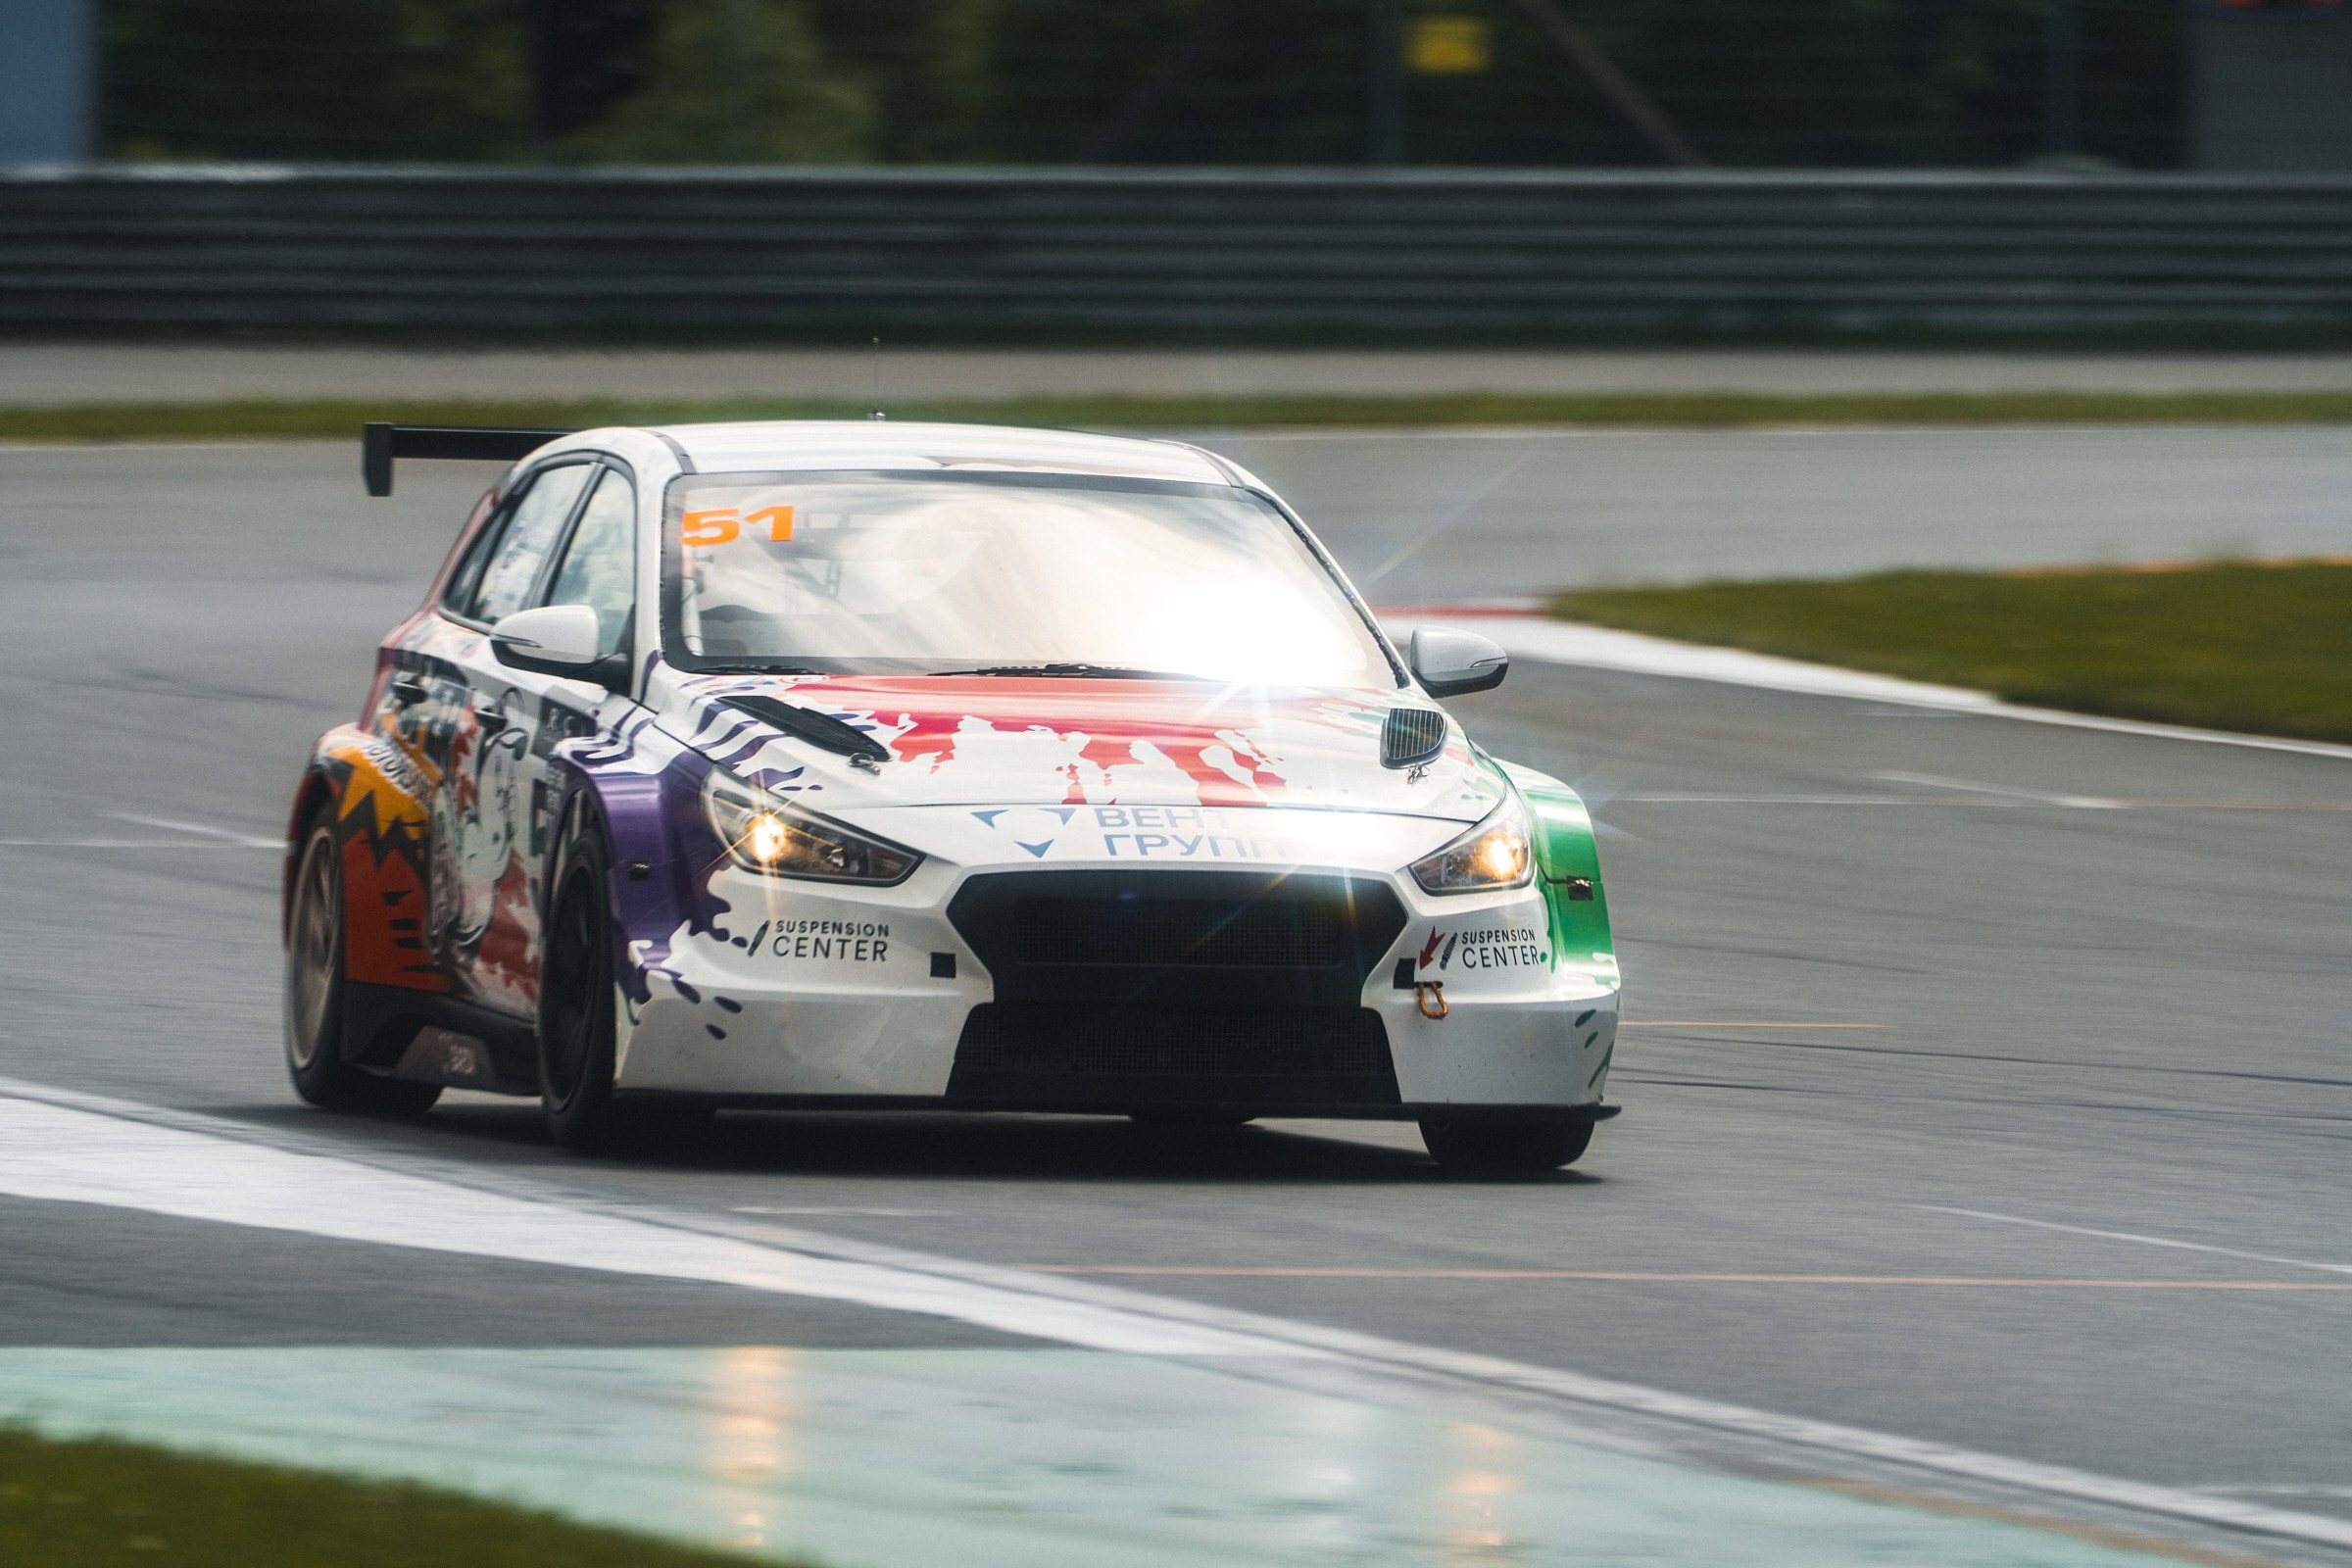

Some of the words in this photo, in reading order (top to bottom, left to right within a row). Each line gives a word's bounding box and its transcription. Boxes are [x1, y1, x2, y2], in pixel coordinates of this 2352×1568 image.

[679, 505, 794, 547] 51
[776, 920, 890, 938] SUSPENSION
[1461, 929, 1536, 945] SUSPENSION
[772, 936, 888, 962] CENTER
[1462, 945, 1540, 968] CENTER
